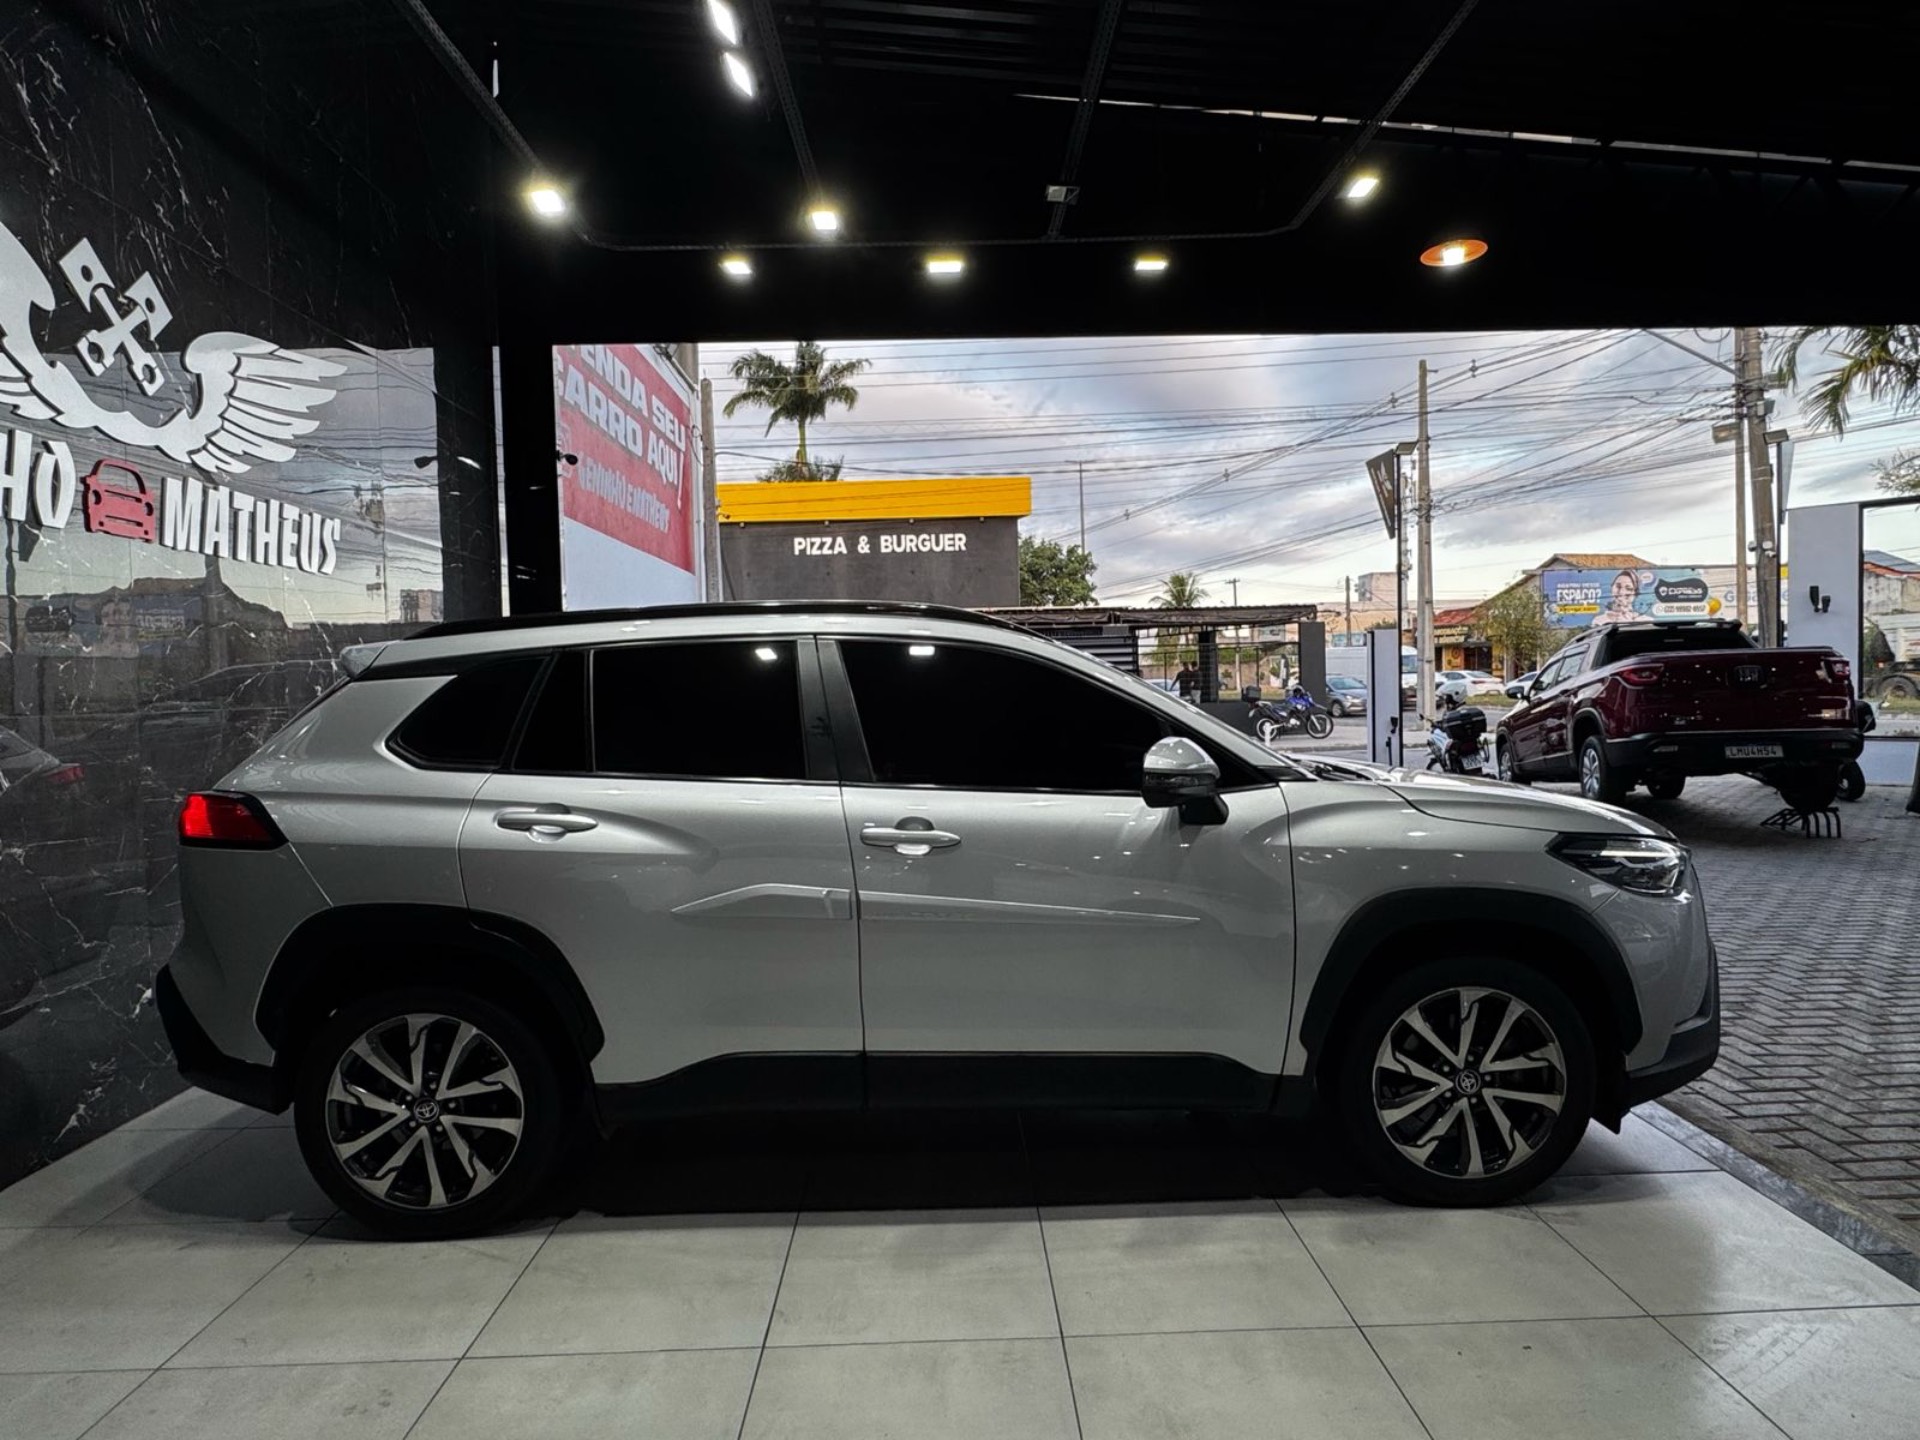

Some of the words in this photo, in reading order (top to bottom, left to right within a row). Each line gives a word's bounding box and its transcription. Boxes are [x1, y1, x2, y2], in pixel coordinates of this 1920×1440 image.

[568, 345, 649, 417] ENDA
[652, 395, 686, 452] SEU
[647, 431, 685, 511] AQUI!
[162, 477, 341, 575] MATHEUS
[793, 536, 848, 555] PIZZA
[857, 535, 871, 554] &
[880, 533, 967, 553] BURGUER
